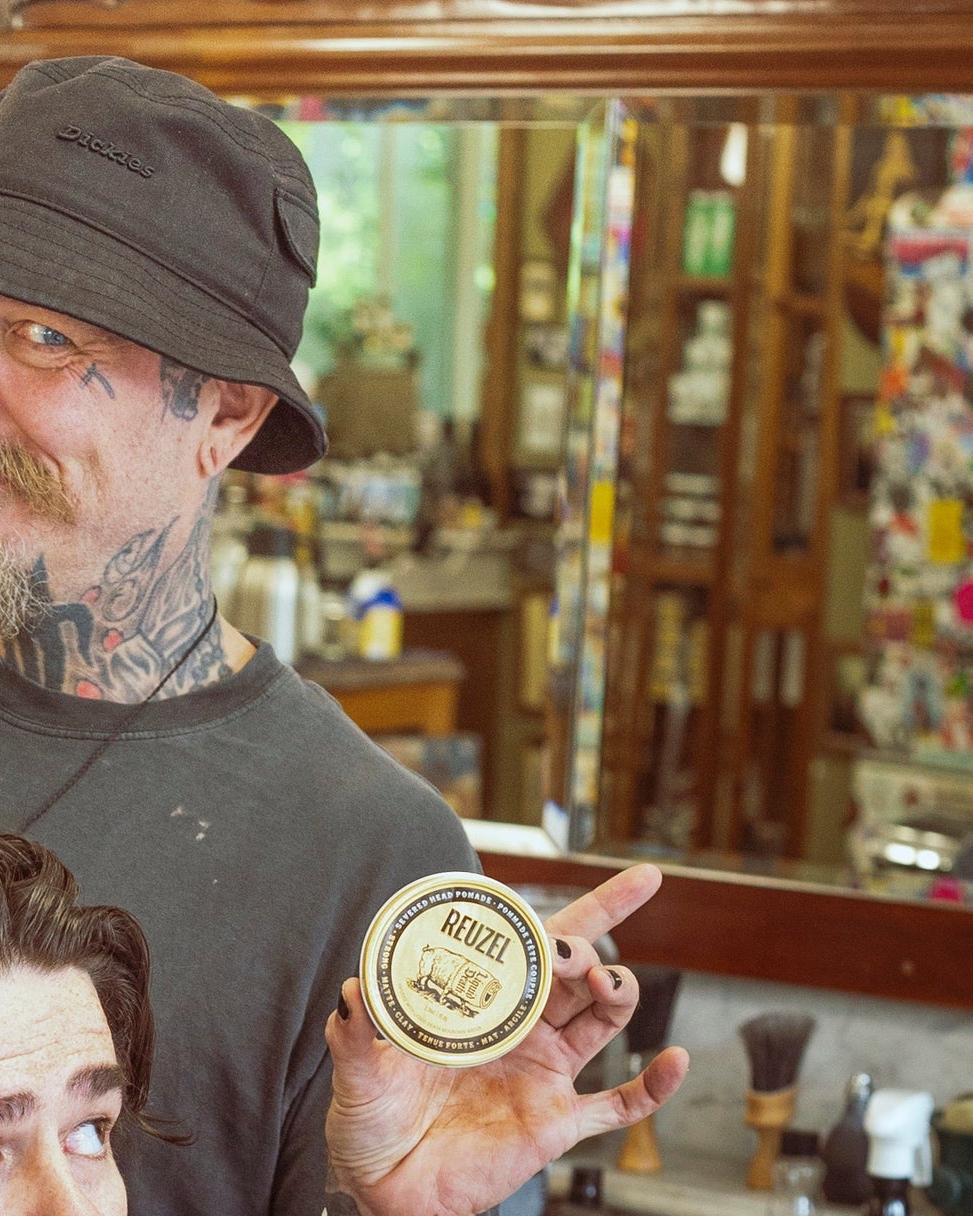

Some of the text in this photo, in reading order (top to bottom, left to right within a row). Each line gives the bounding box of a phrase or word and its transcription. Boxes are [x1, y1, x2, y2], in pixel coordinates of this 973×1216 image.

[56, 124, 156, 179] Dickies
[395, 890, 492, 930] SEVERED HEAD POMADE
[497, 902, 531, 940] POMMADE
[440, 908, 513, 965] REUZEL
[381, 976, 396, 1008] MATTE
[394, 1011, 414, 1032] CLAY
[503, 1004, 528, 1033] ARGILE
[418, 1031, 475, 1050] TENUE FORTE
[480, 1031, 500, 1046] MAT
